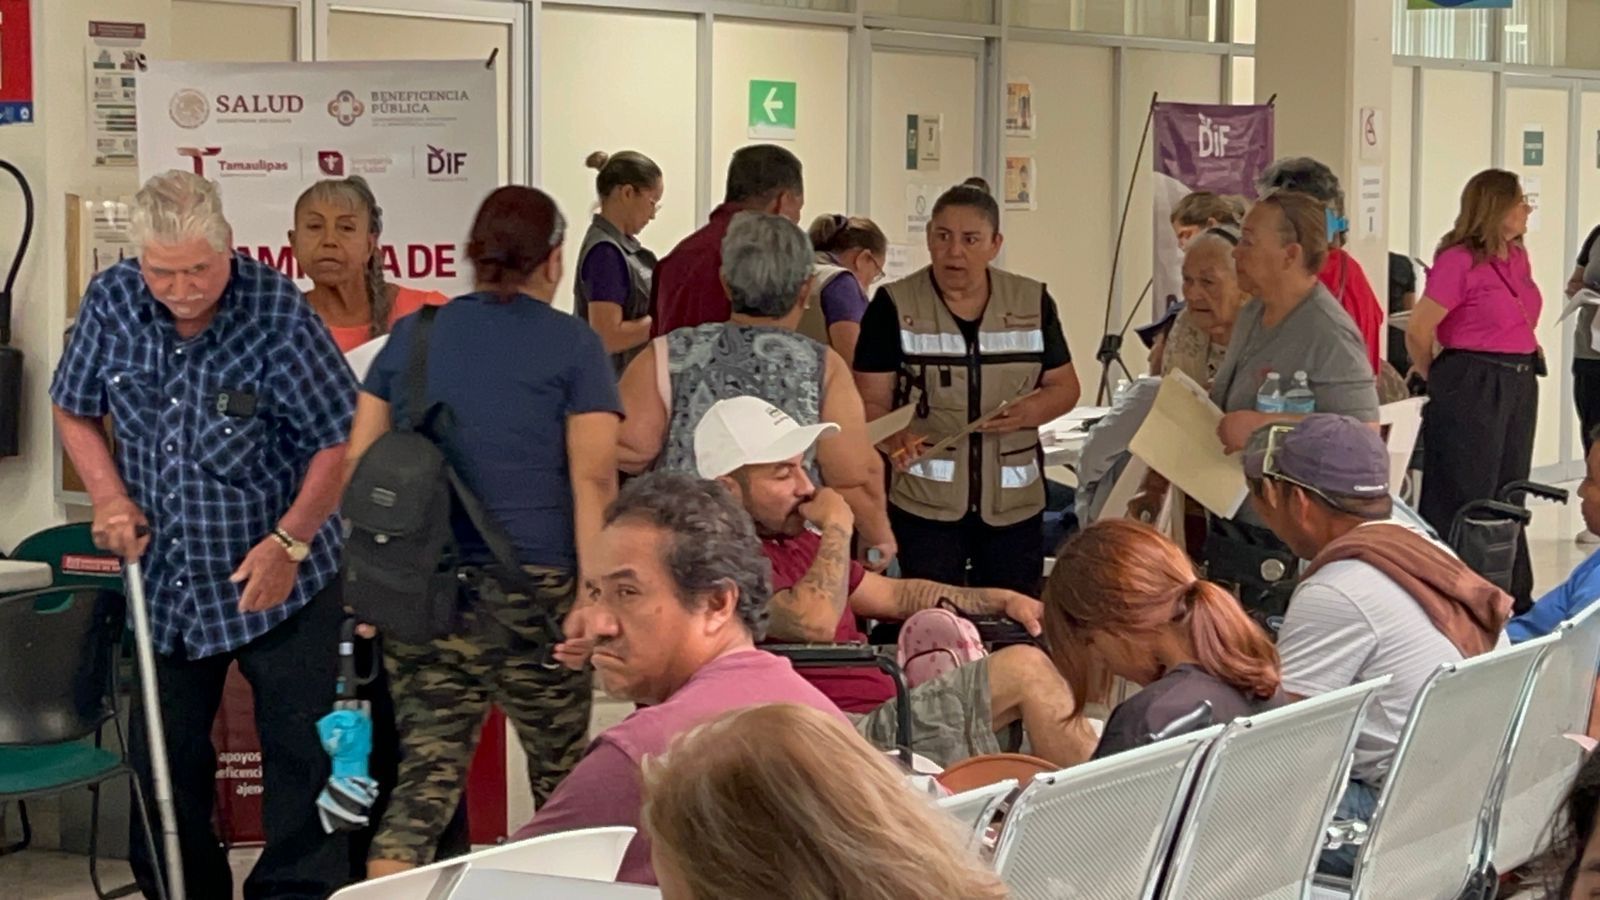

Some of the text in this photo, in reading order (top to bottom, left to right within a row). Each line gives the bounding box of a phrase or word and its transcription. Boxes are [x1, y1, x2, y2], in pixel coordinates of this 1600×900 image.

[371, 90, 470, 101] BENEFICENCIA
[216, 94, 304, 114] SALUD
[371, 101, 430, 114] PÚBLICA
[217, 159, 288, 173] Tamaulipas
[407, 244, 456, 279] DE
[218, 752, 262, 765] apoyos
